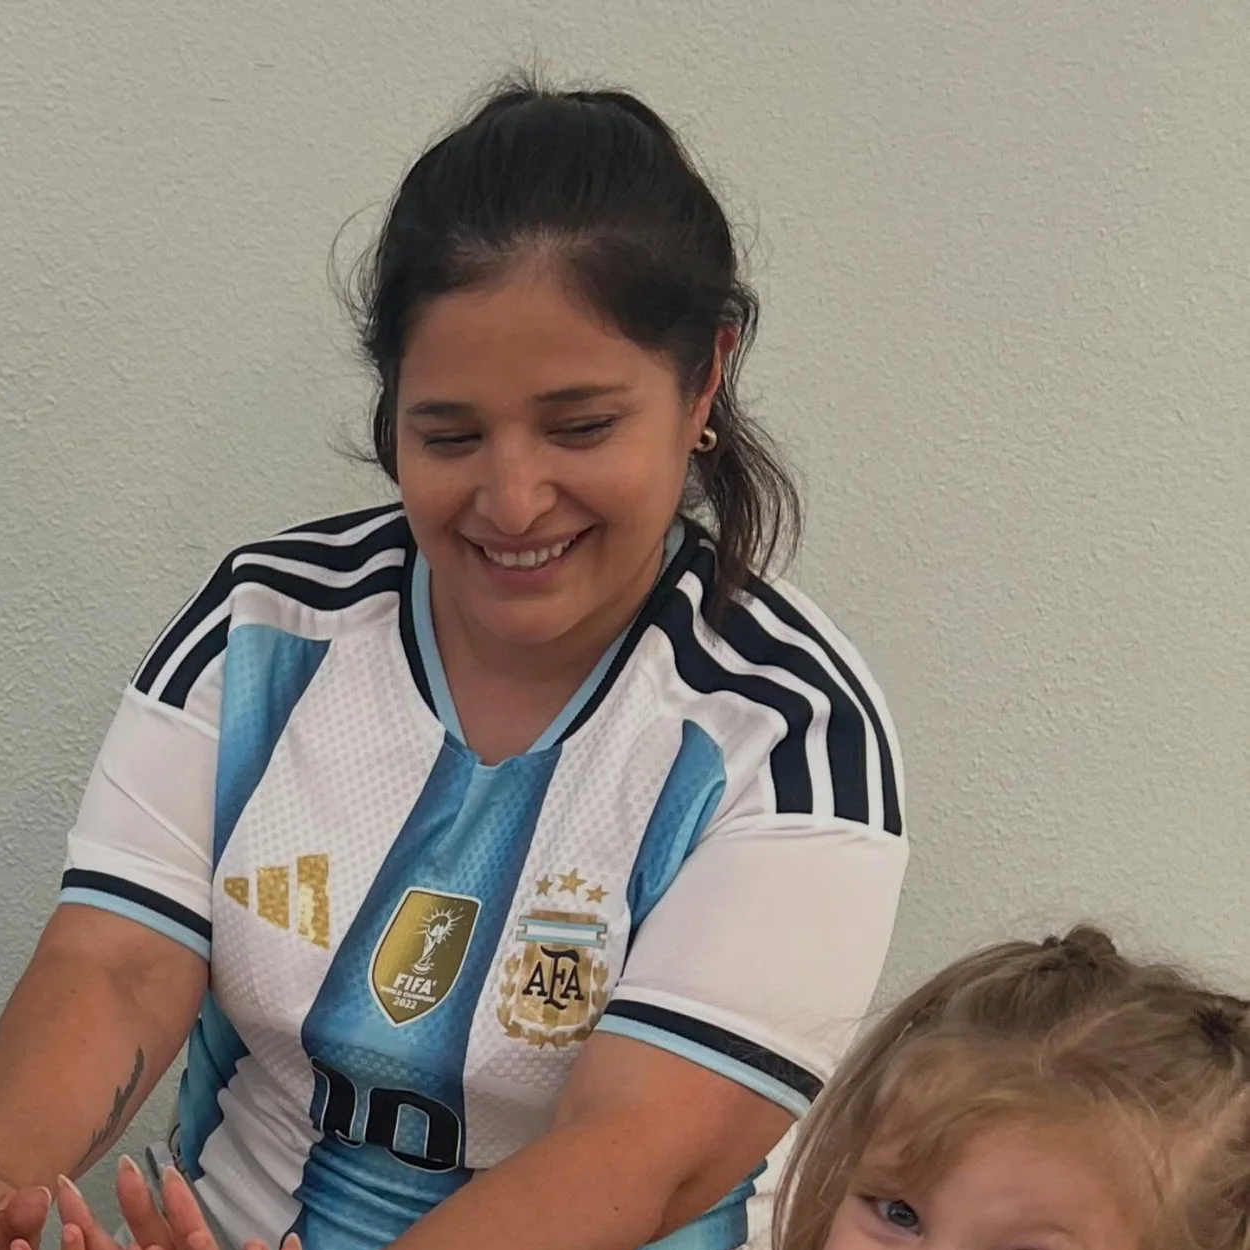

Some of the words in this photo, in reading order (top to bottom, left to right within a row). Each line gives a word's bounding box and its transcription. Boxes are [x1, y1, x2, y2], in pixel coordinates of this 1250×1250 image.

[392, 973, 433, 995] FIFA
[522, 946, 584, 1010] AFA
[392, 996, 417, 1010] 2022
